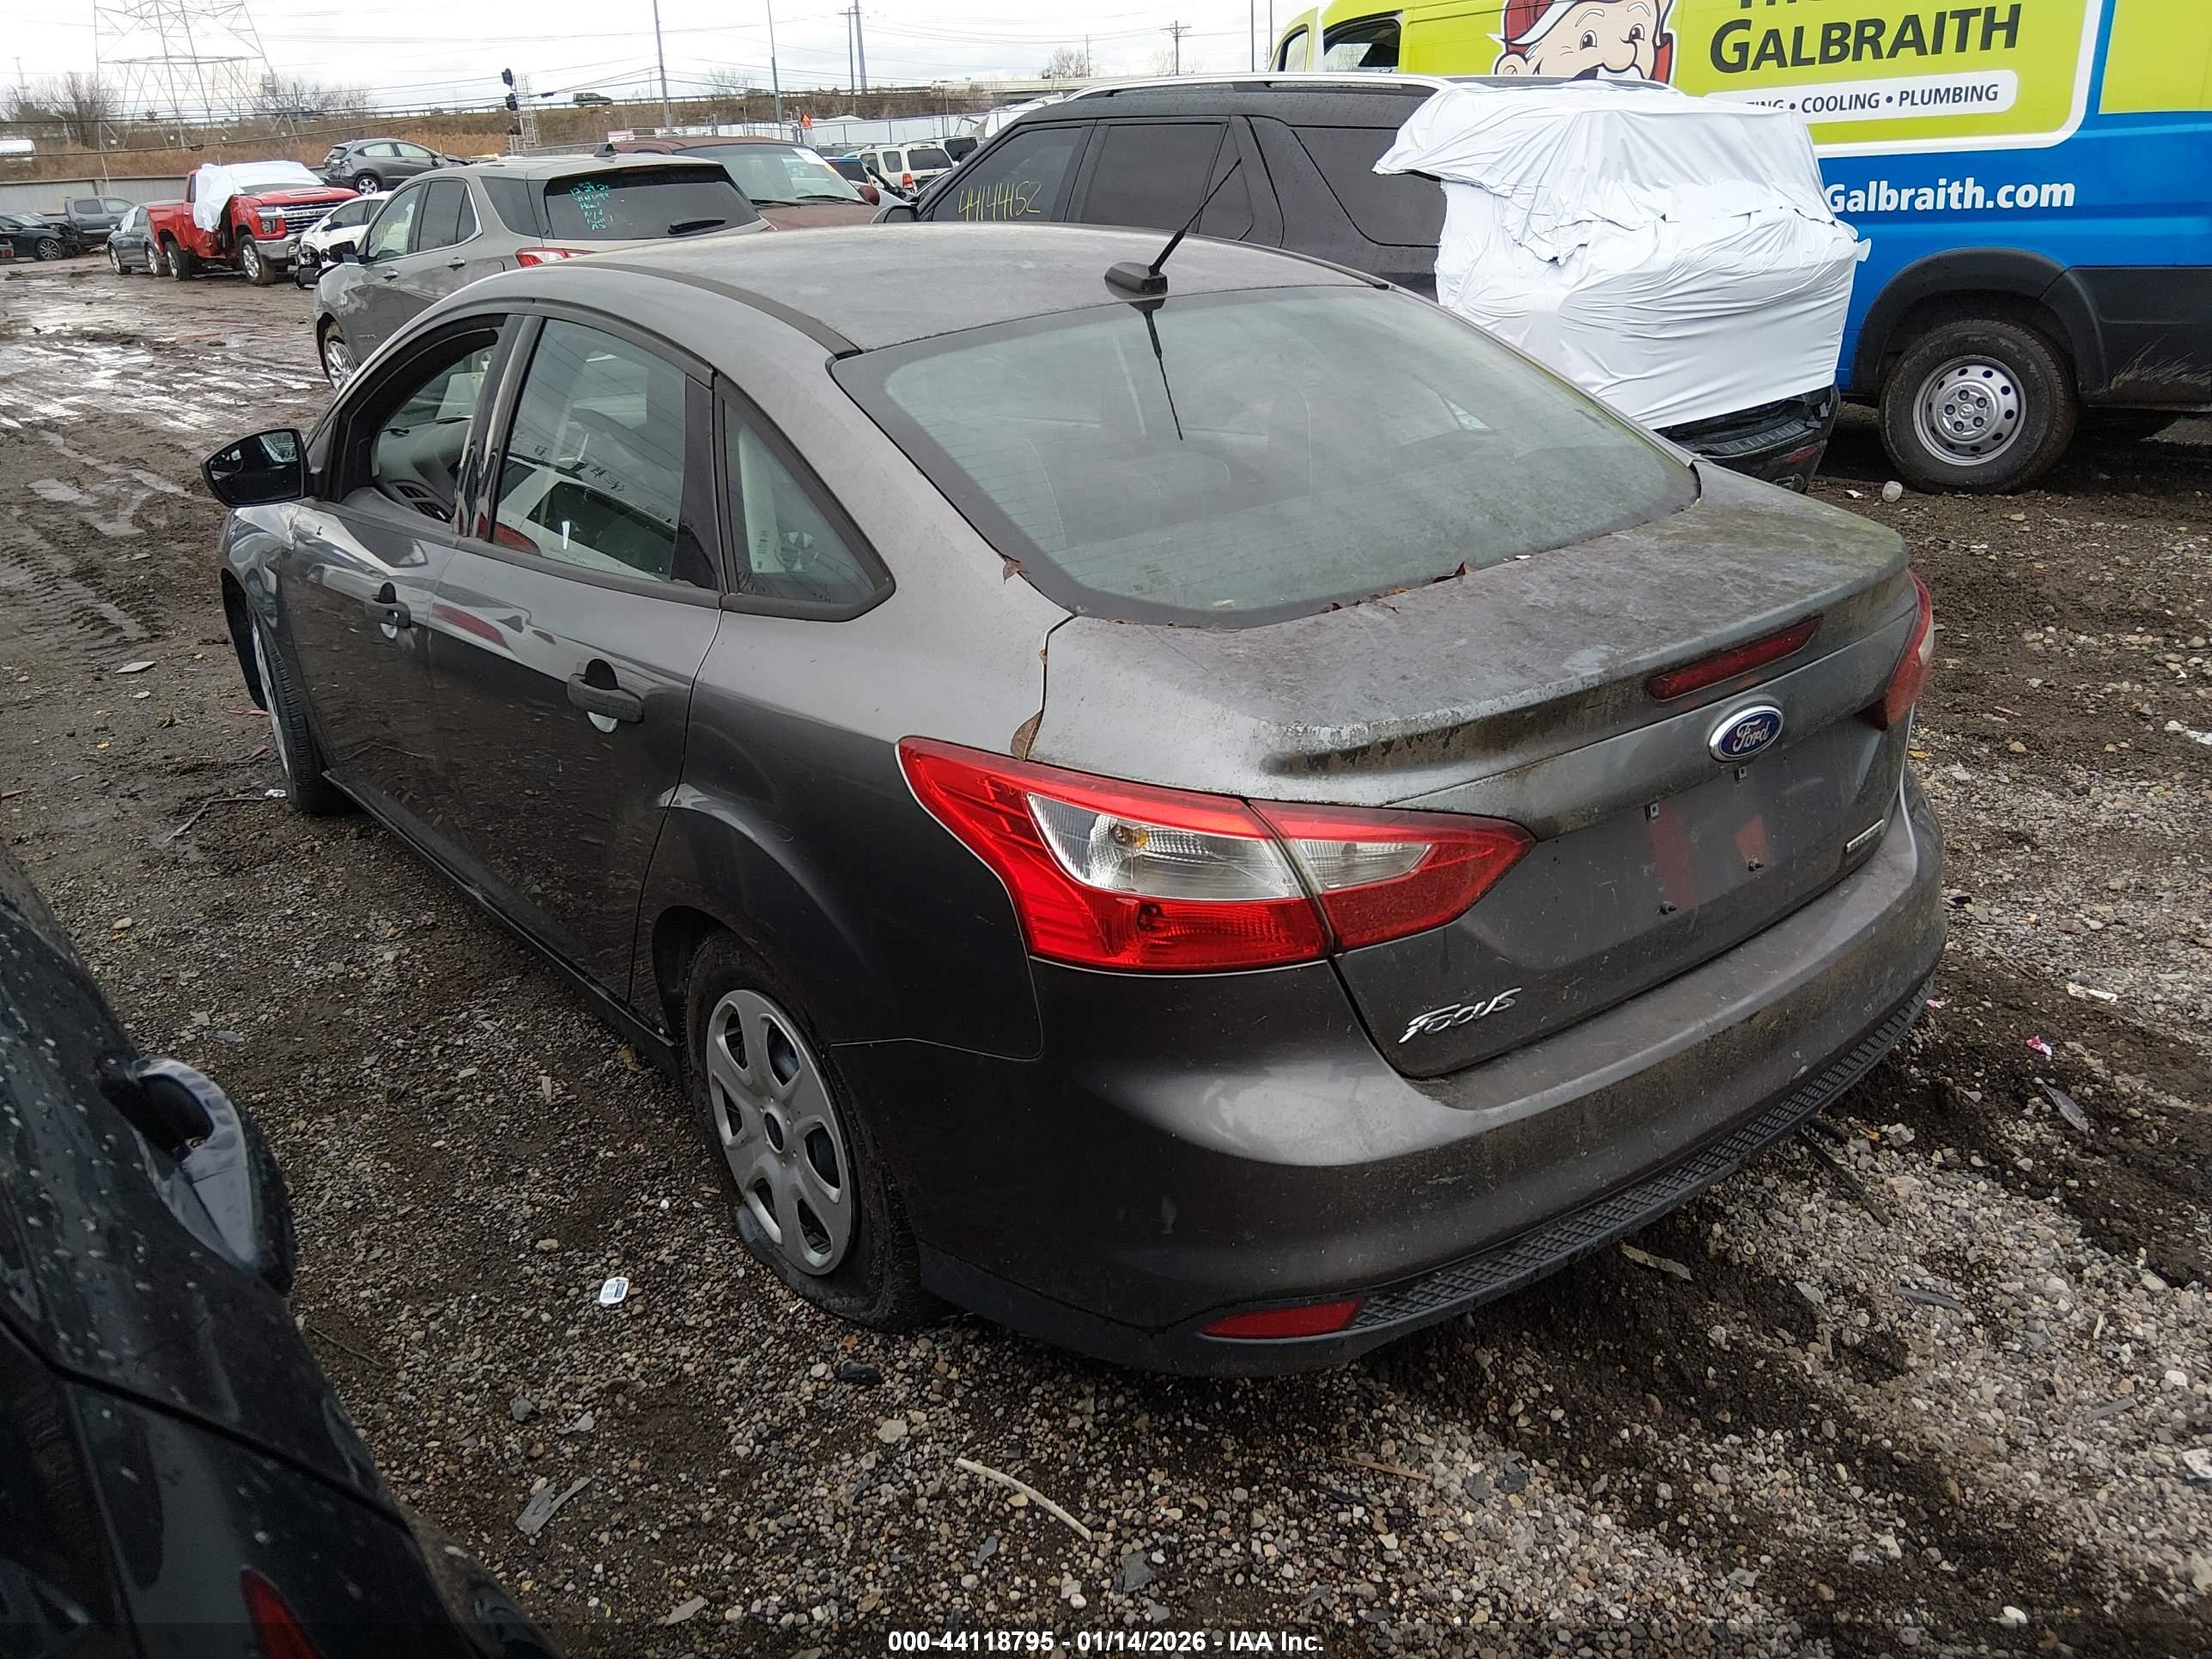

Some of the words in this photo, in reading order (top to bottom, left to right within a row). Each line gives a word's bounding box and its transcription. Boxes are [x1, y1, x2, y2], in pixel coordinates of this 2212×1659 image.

[1711, 3, 2022, 74] GALBRAITH
[1801, 92, 1881, 113] COOLING
[1898, 83, 1999, 107] PLUMBING
[957, 180, 1042, 222] 44144152
[1824, 177, 2075, 213] Galbraith.com
[1732, 718, 1771, 752] Ford
[1397, 987, 1522, 1043] Focus
